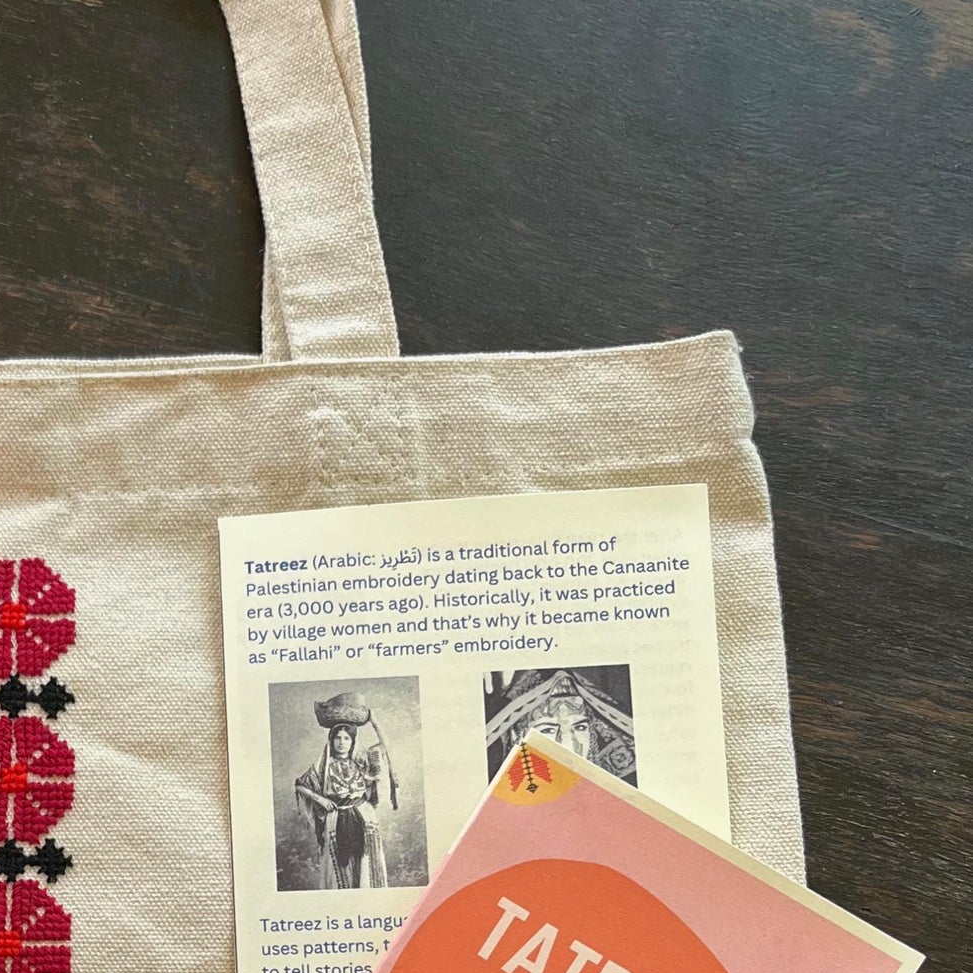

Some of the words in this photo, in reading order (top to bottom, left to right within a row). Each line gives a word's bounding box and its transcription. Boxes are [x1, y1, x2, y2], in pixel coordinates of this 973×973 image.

[244, 558, 308, 574] Tatreez
[312, 552, 376, 570] (Arabic:
[427, 548, 440, 562] is
[445, 551, 455, 561] a
[459, 540, 549, 560] traditional
[552, 539, 593, 554] form
[598, 536, 617, 552] of
[246, 578, 337, 597] Palestinian
[342, 571, 440, 589] embroidery
[445, 568, 498, 585] dating
[503, 565, 543, 581] back
[547, 566, 565, 578] to
[570, 562, 598, 576] the
[603, 557, 690, 575] Canaanite
[247, 607, 273, 619] era
[278, 600, 334, 619] (3,000
[339, 599, 384, 617] years
[388, 594, 429, 613] ago).
[434, 589, 535, 608] Historically,
[540, 587, 552, 601] it
[556, 588, 588, 600] was
[594, 580, 676, 602] practiced
[248, 627, 268, 644] by
[273, 624, 326, 641] village
[331, 622, 392, 636] women
[397, 617, 428, 632] and
[433, 614, 481, 630] that’s
[486, 612, 520, 630] why
[525, 611, 537, 626] it
[542, 607, 609, 625] became
[614, 605, 670, 620] known
[249, 652, 266, 664] as
[271, 645, 341, 662] “Fallahi”
[346, 648, 364, 659] or
[368, 639, 449, 657] “farmers”
[454, 635, 559, 653] embroidery.
[260, 918, 322, 932] Tatreez
[326, 916, 339, 930] is
[344, 919, 354, 929] a
[262, 943, 299, 955] uses
[303, 940, 379, 958] patterns,
